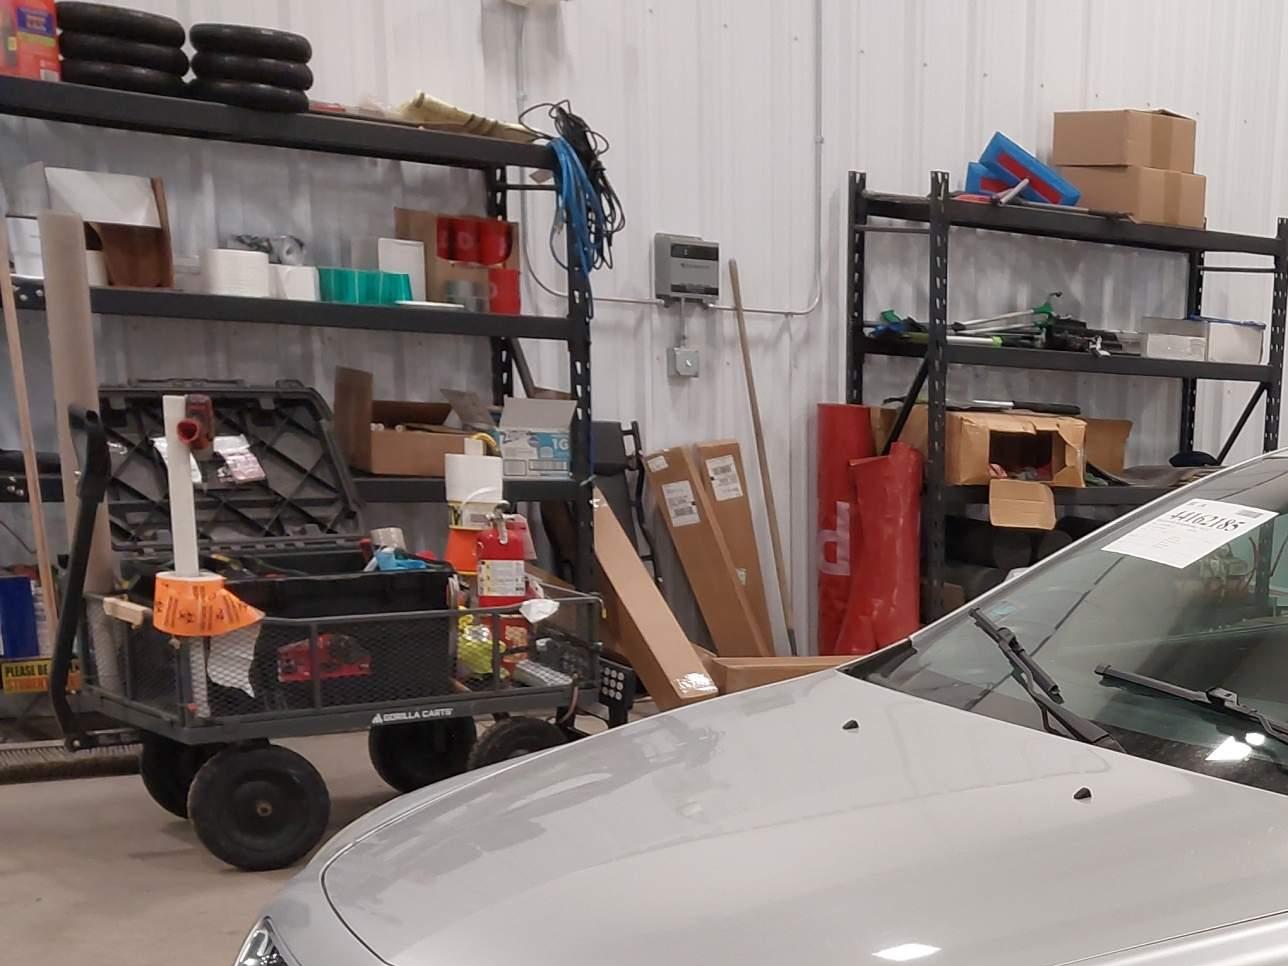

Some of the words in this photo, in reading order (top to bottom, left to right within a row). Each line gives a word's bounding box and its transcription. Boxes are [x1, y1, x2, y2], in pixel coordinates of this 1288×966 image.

[1170, 510, 1246, 531] 44162185
[4, 663, 35, 677] PLEASE
[37, 662, 49, 676] BE
[383, 711, 420, 721] GORILLA
